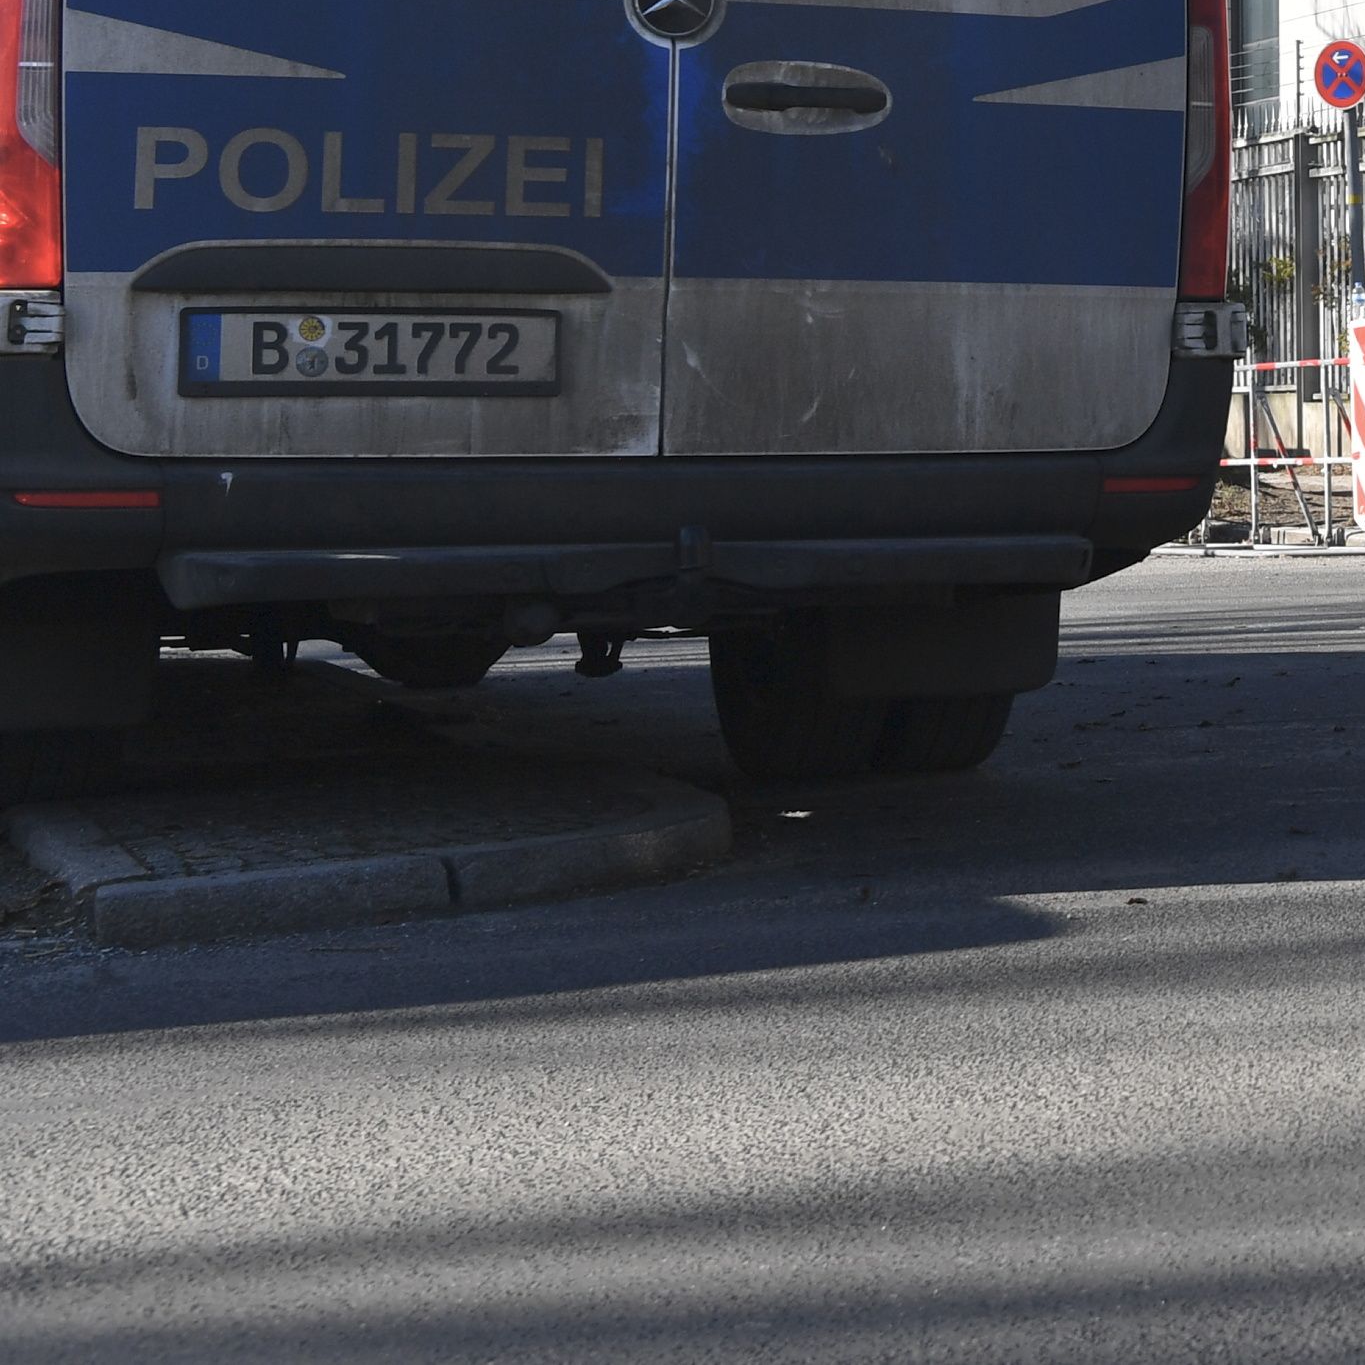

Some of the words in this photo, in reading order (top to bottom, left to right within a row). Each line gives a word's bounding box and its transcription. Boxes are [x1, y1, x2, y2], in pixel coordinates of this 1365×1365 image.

[134, 126, 603, 217] POLIZEI
[196, 355, 209, 371] D
[252, 321, 290, 375] B
[335, 321, 520, 375] 31772
